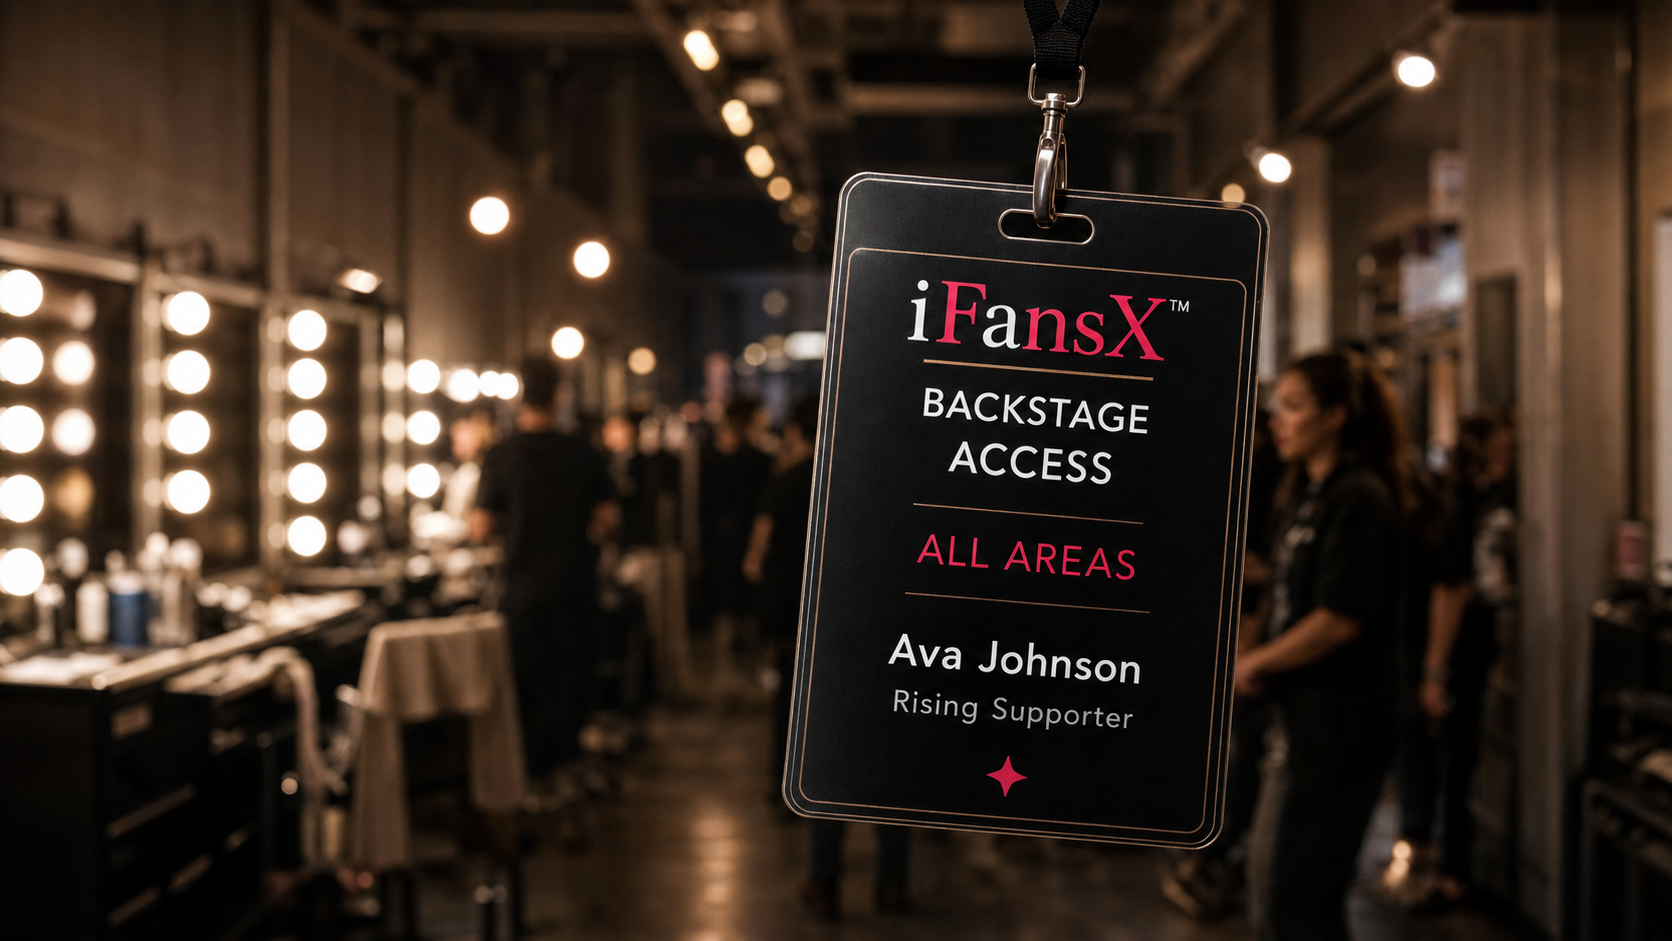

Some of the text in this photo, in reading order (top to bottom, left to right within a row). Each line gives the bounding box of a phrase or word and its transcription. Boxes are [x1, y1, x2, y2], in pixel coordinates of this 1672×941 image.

[922, 387, 1150, 435] BACKSTAGE
[947, 440, 1113, 485] ACCESS
[916, 533, 1137, 581] ALL AREAS
[887, 633, 1142, 685] Ava Johnson
[892, 689, 1134, 730] Rising Supporter
